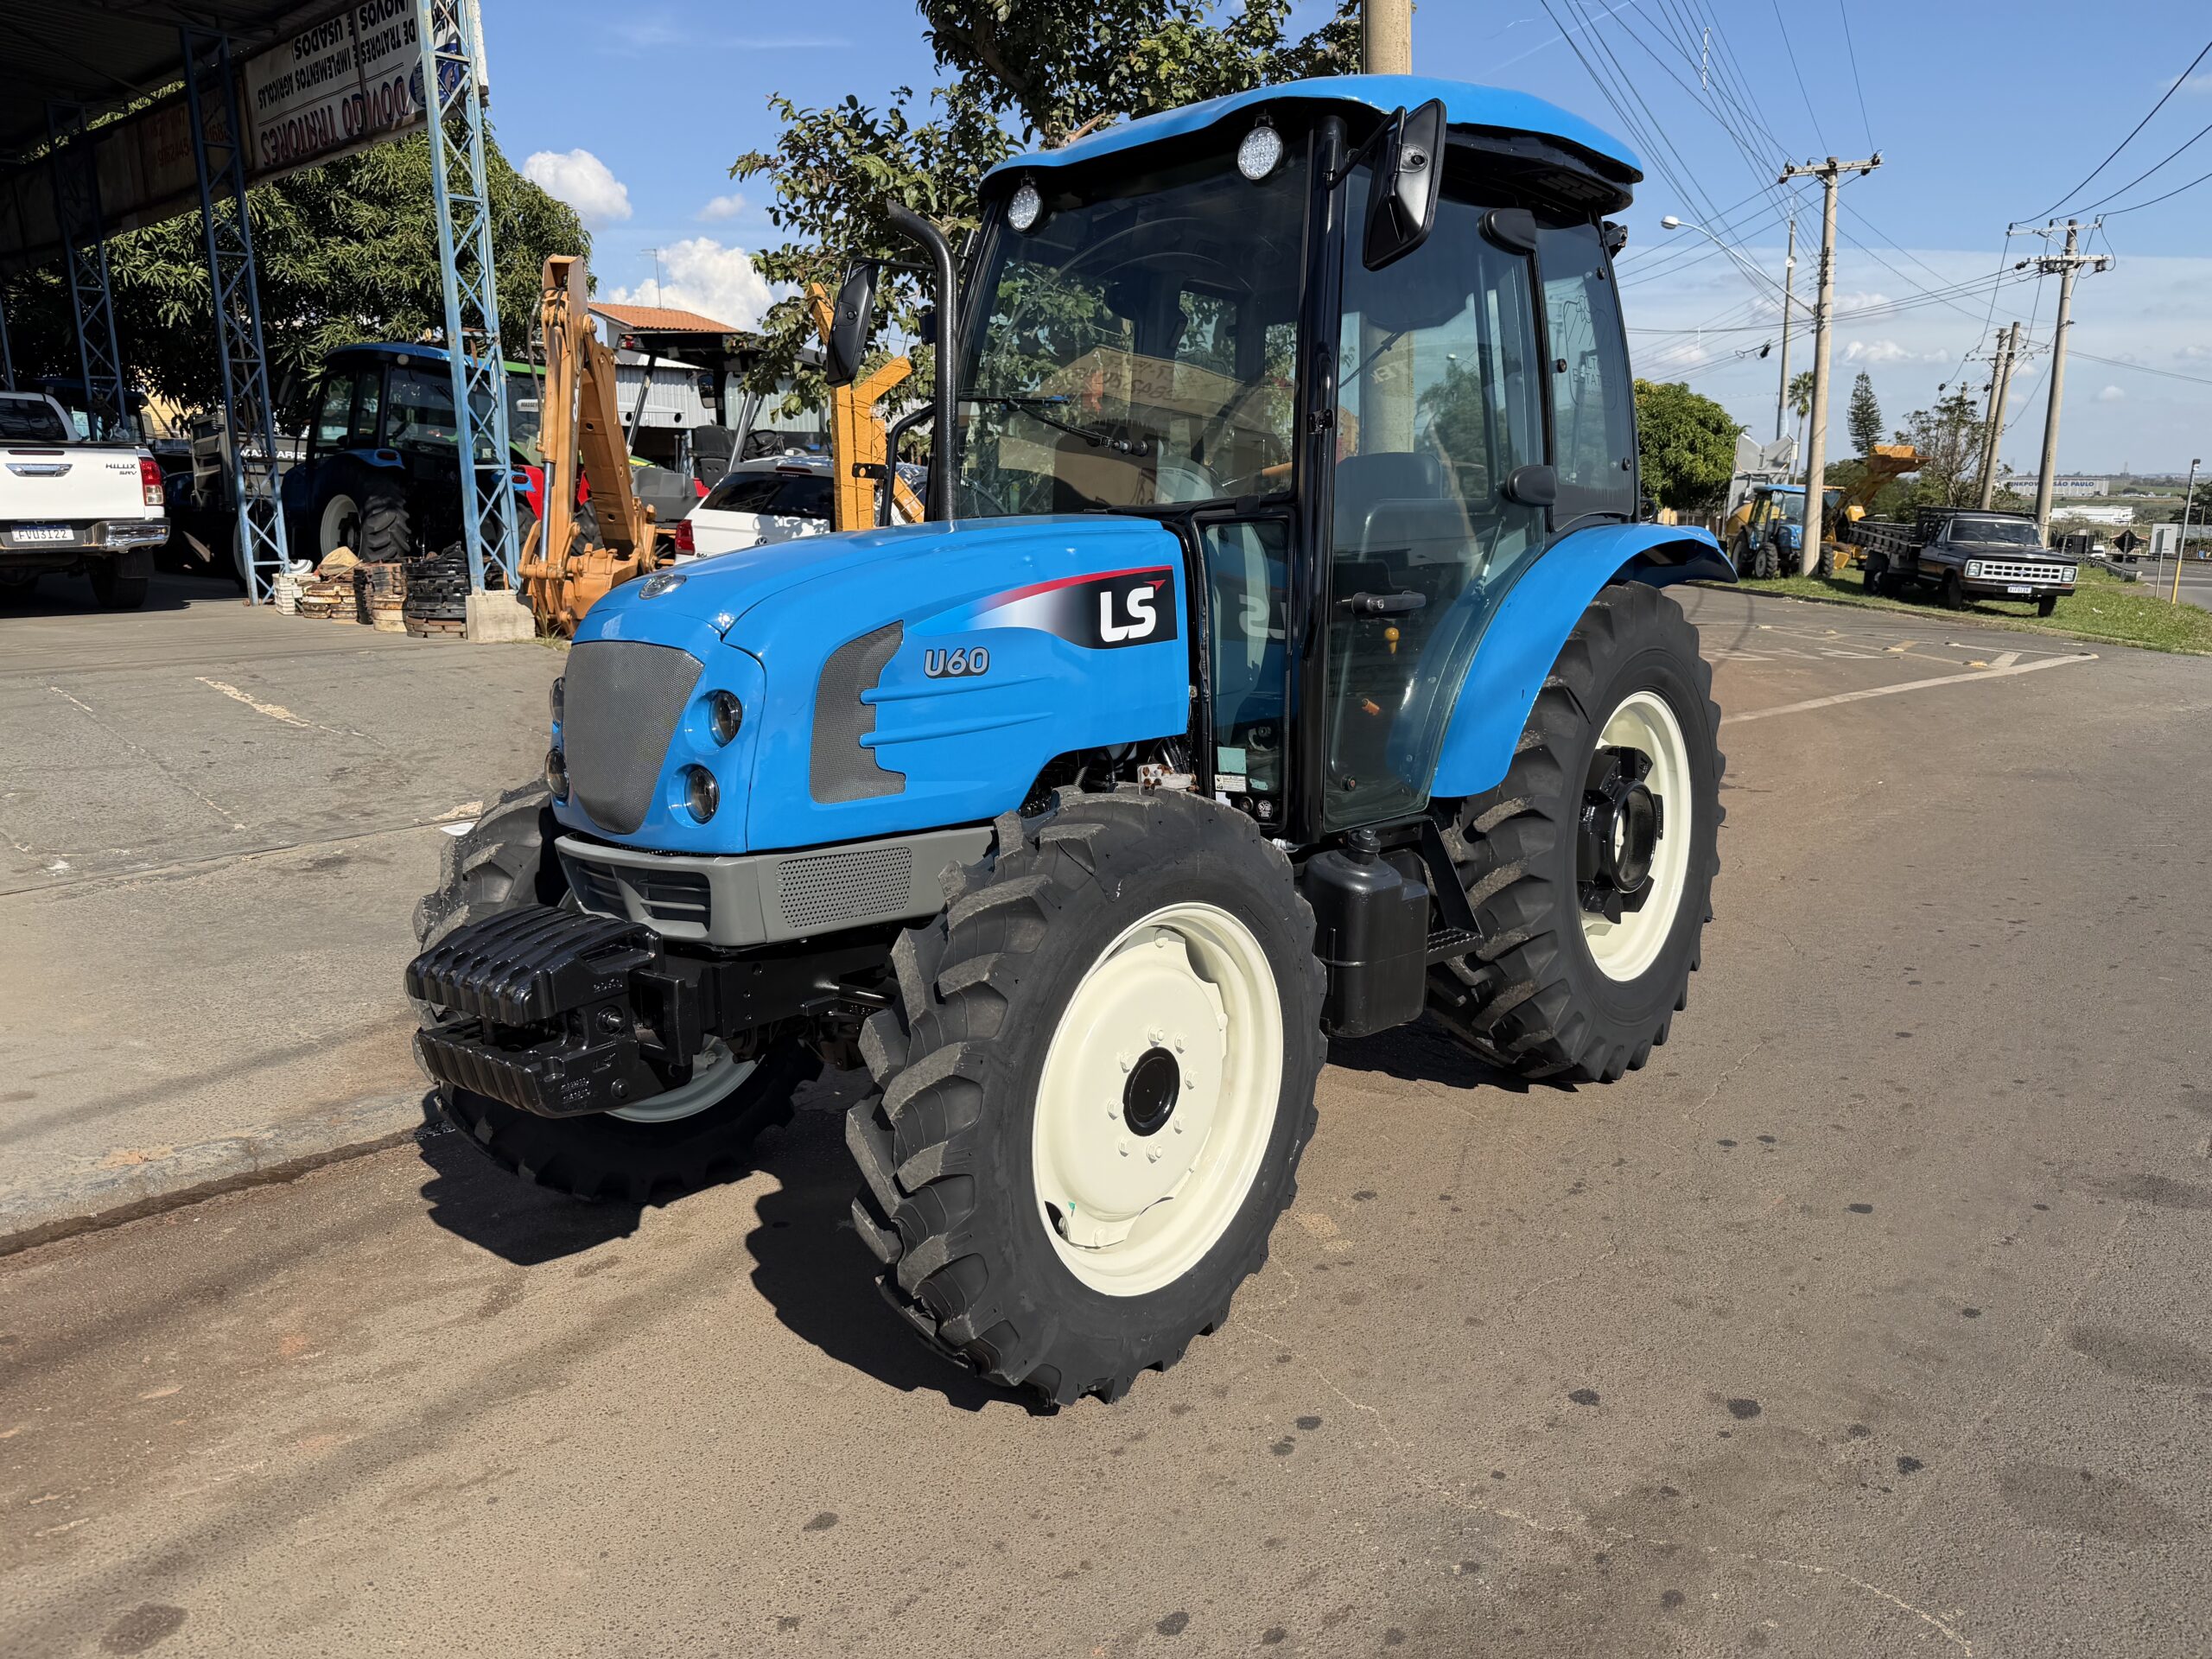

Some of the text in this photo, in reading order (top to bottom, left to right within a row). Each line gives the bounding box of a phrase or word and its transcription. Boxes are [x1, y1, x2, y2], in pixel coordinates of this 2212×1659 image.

[360, 24, 403, 65] TRATORES
[403, 17, 416, 44] DE
[295, 47, 352, 90] IMPLEMENTOS
[257, 74, 294, 110] AGRÍCOLAS
[341, 74, 410, 134] DOVIGO
[261, 105, 339, 165] TRATORES
[1100, 587, 1156, 642] LS
[924, 647, 989, 678] U60
